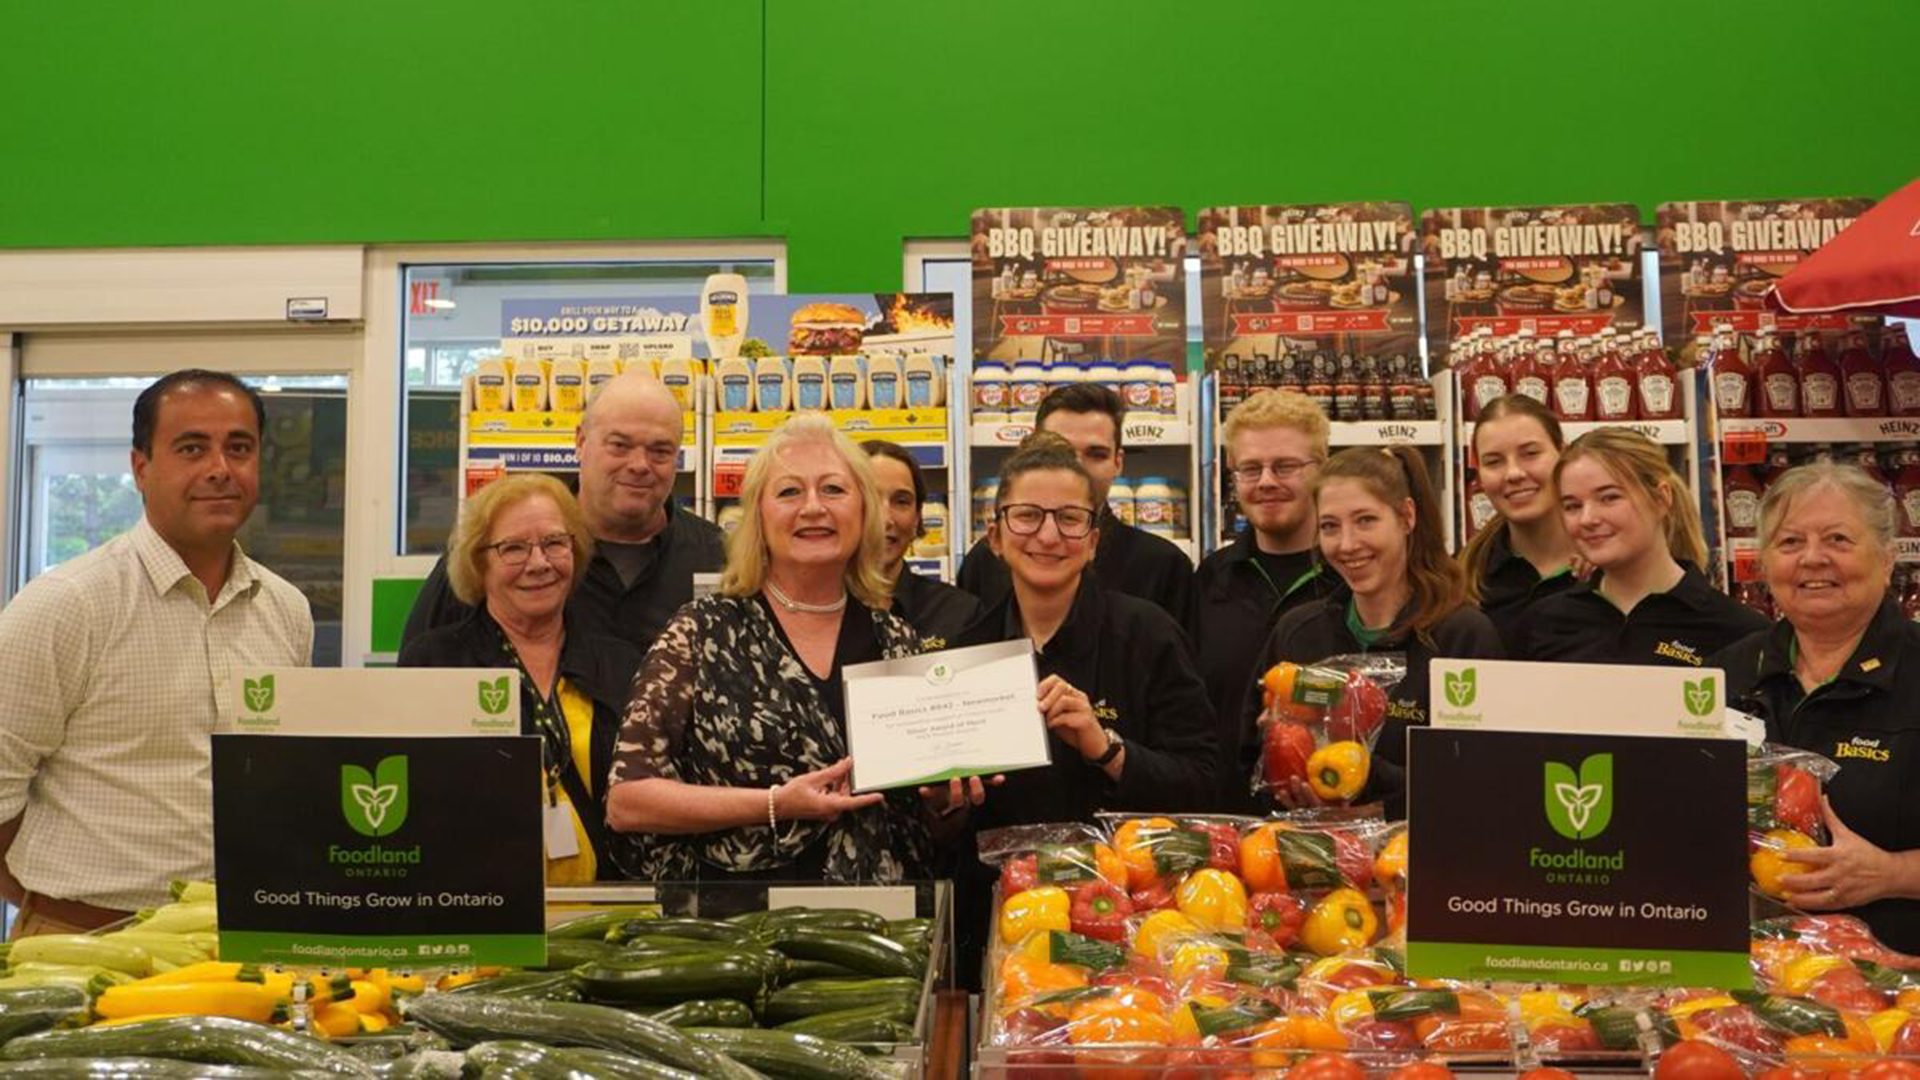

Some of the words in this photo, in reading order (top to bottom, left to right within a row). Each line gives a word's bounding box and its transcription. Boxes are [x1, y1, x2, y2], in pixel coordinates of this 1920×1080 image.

[988, 228, 1035, 261] BBQ
[1042, 226, 1167, 257] GIVEAWAY!
[1217, 226, 1264, 259] BBQ
[1271, 221, 1398, 255] GIVEAWAY!
[1440, 228, 1487, 261] BBQ
[1495, 224, 1622, 257] GIVEAWAY!
[1676, 221, 1724, 254] BBQ
[410, 279, 438, 314] XIT
[582, 306, 601, 315] YOUR
[603, 306, 619, 315] WAY
[510, 317, 588, 334] $10,000
[592, 316, 688, 332] GETAWAY
[1125, 425, 1164, 439] HEINZ
[1379, 425, 1418, 439] HEINZ
[1880, 420, 1920, 435] HEINZ
[499, 453, 515, 464] WIN
[543, 453, 580, 464] $10,00
[1654, 641, 1703, 667] Basics
[1671, 640, 1697, 654] food
[237, 716, 281, 727] Foodland
[471, 718, 515, 728] Foodland
[1437, 711, 1482, 722] Foodland
[1677, 719, 1722, 731] Foodland
[1851, 736, 1881, 748] food
[1835, 742, 1890, 761] Basics
[328, 846, 421, 864] Foodland
[1530, 847, 1624, 870] Foodland
[345, 868, 408, 878] ONTARIO
[1546, 873, 1610, 885] ONTARIO
[254, 889, 300, 906] Good
[305, 891, 361, 910] Things
[366, 892, 412, 907] Grow
[417, 891, 433, 907] in
[438, 892, 504, 907] Ontario
[1448, 896, 1498, 914] Good
[1503, 898, 1562, 917] Things
[1567, 901, 1614, 918] Grow
[1619, 901, 1635, 917] in
[1641, 902, 1707, 920] Ontario
[292, 943, 408, 958] foodlandontario.ca
[1485, 956, 1609, 972] foodlandontario.ca
